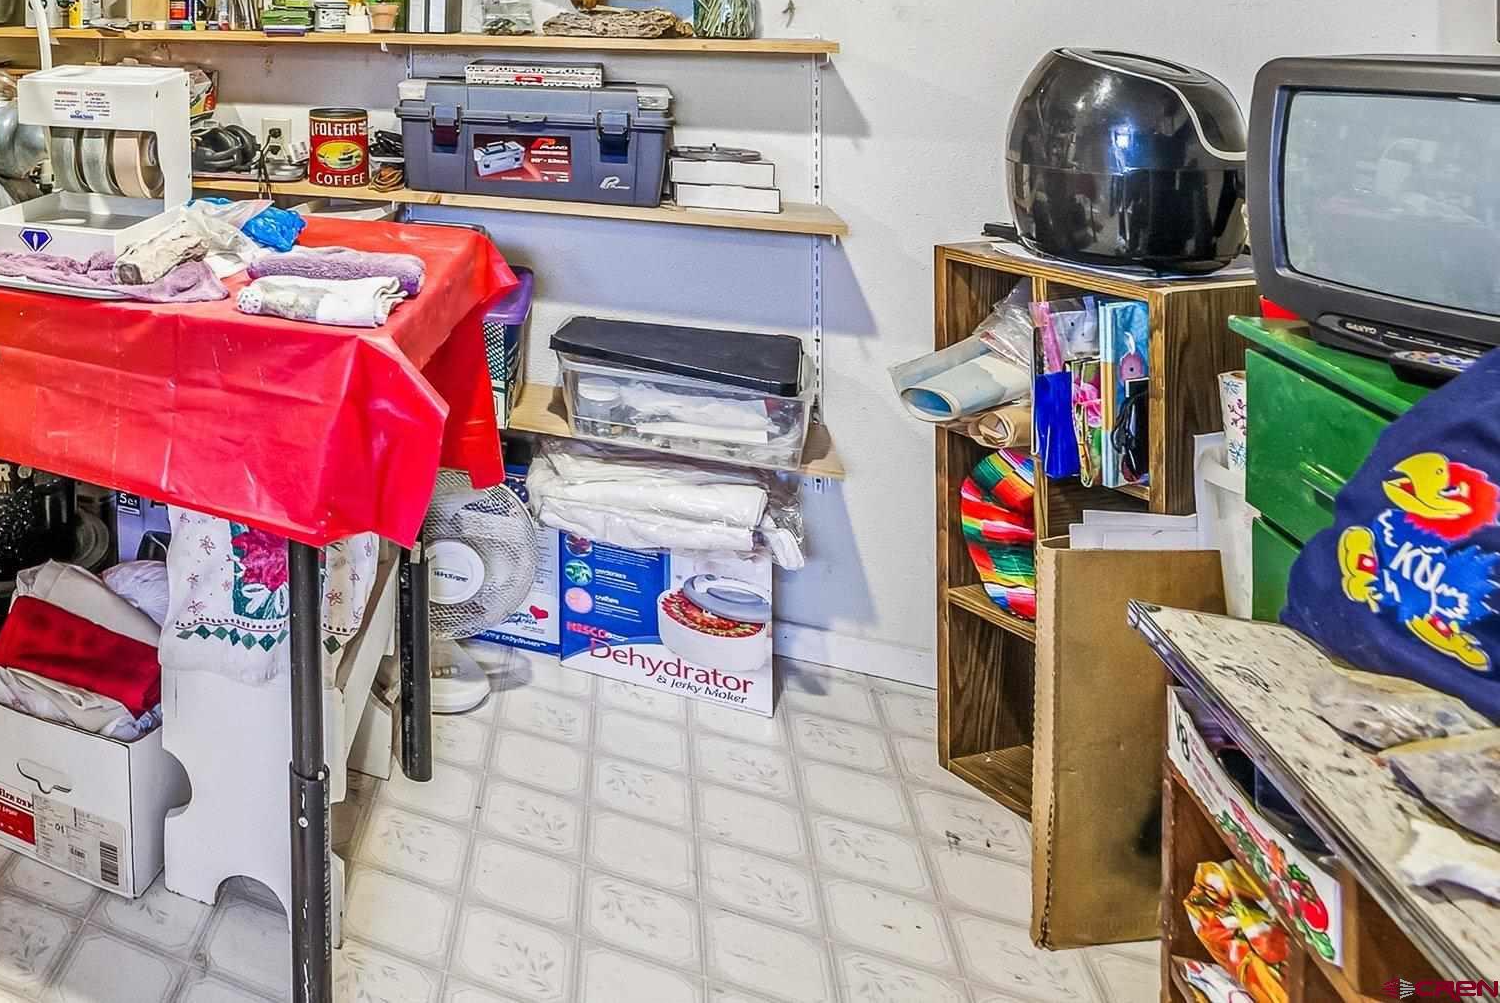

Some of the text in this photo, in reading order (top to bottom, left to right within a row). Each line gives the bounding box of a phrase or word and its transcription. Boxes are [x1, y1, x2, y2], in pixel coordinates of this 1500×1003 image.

[315, 171, 366, 186] COFFEE
[589, 637, 754, 694] Dehydrator
[671, 679, 702, 695] Jerky
[704, 685, 748, 705] Maker
